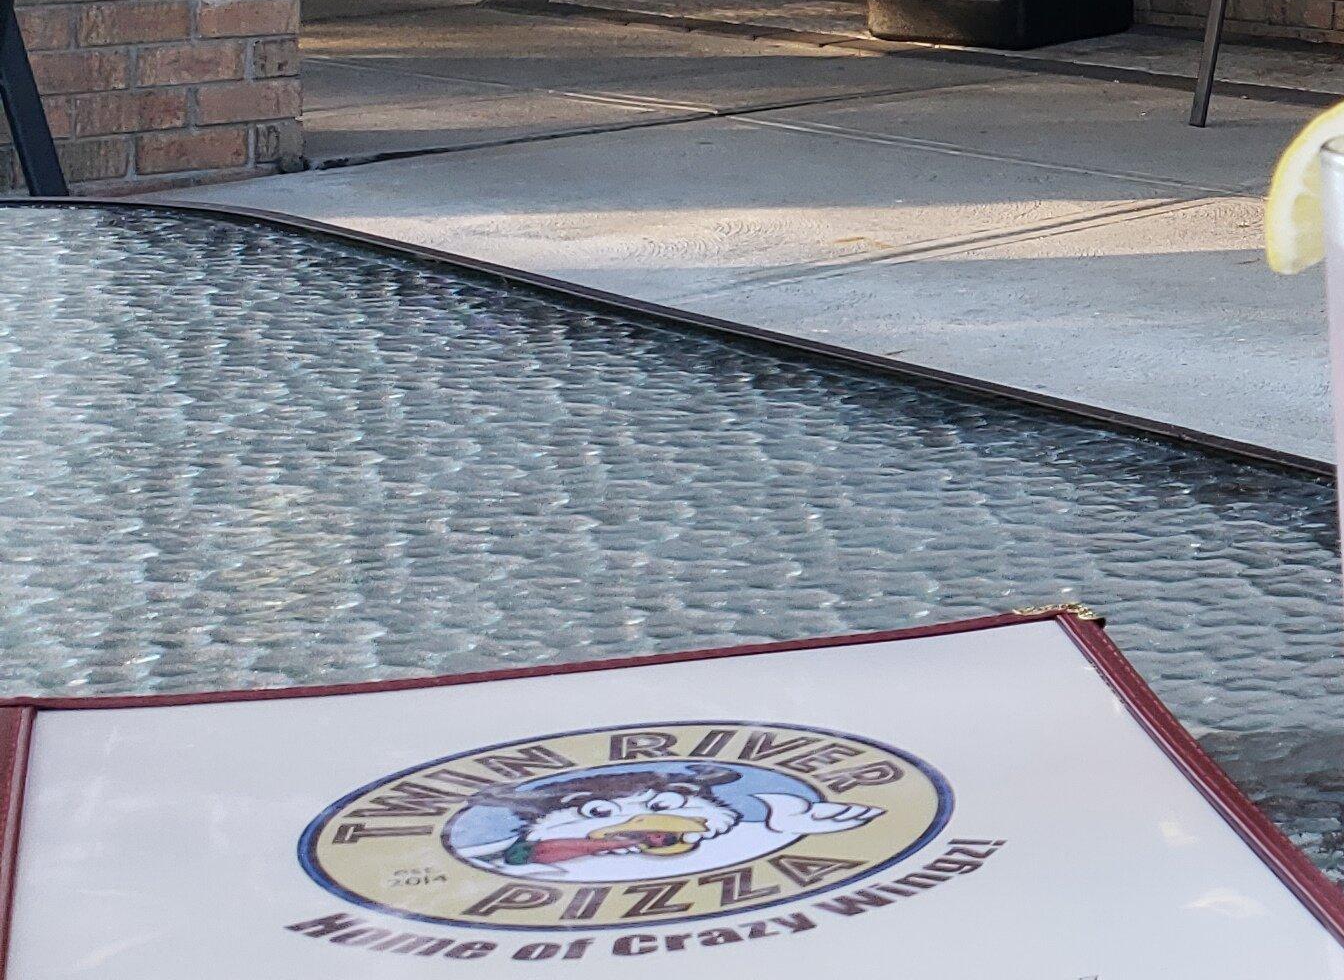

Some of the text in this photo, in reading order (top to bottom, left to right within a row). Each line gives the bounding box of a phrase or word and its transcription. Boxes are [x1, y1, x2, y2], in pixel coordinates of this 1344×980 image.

[331, 727, 909, 847] TWIN RIVER
[285, 837, 1009, 961] Home of Crazy Wingz!
[461, 854, 870, 920] PIZZA
